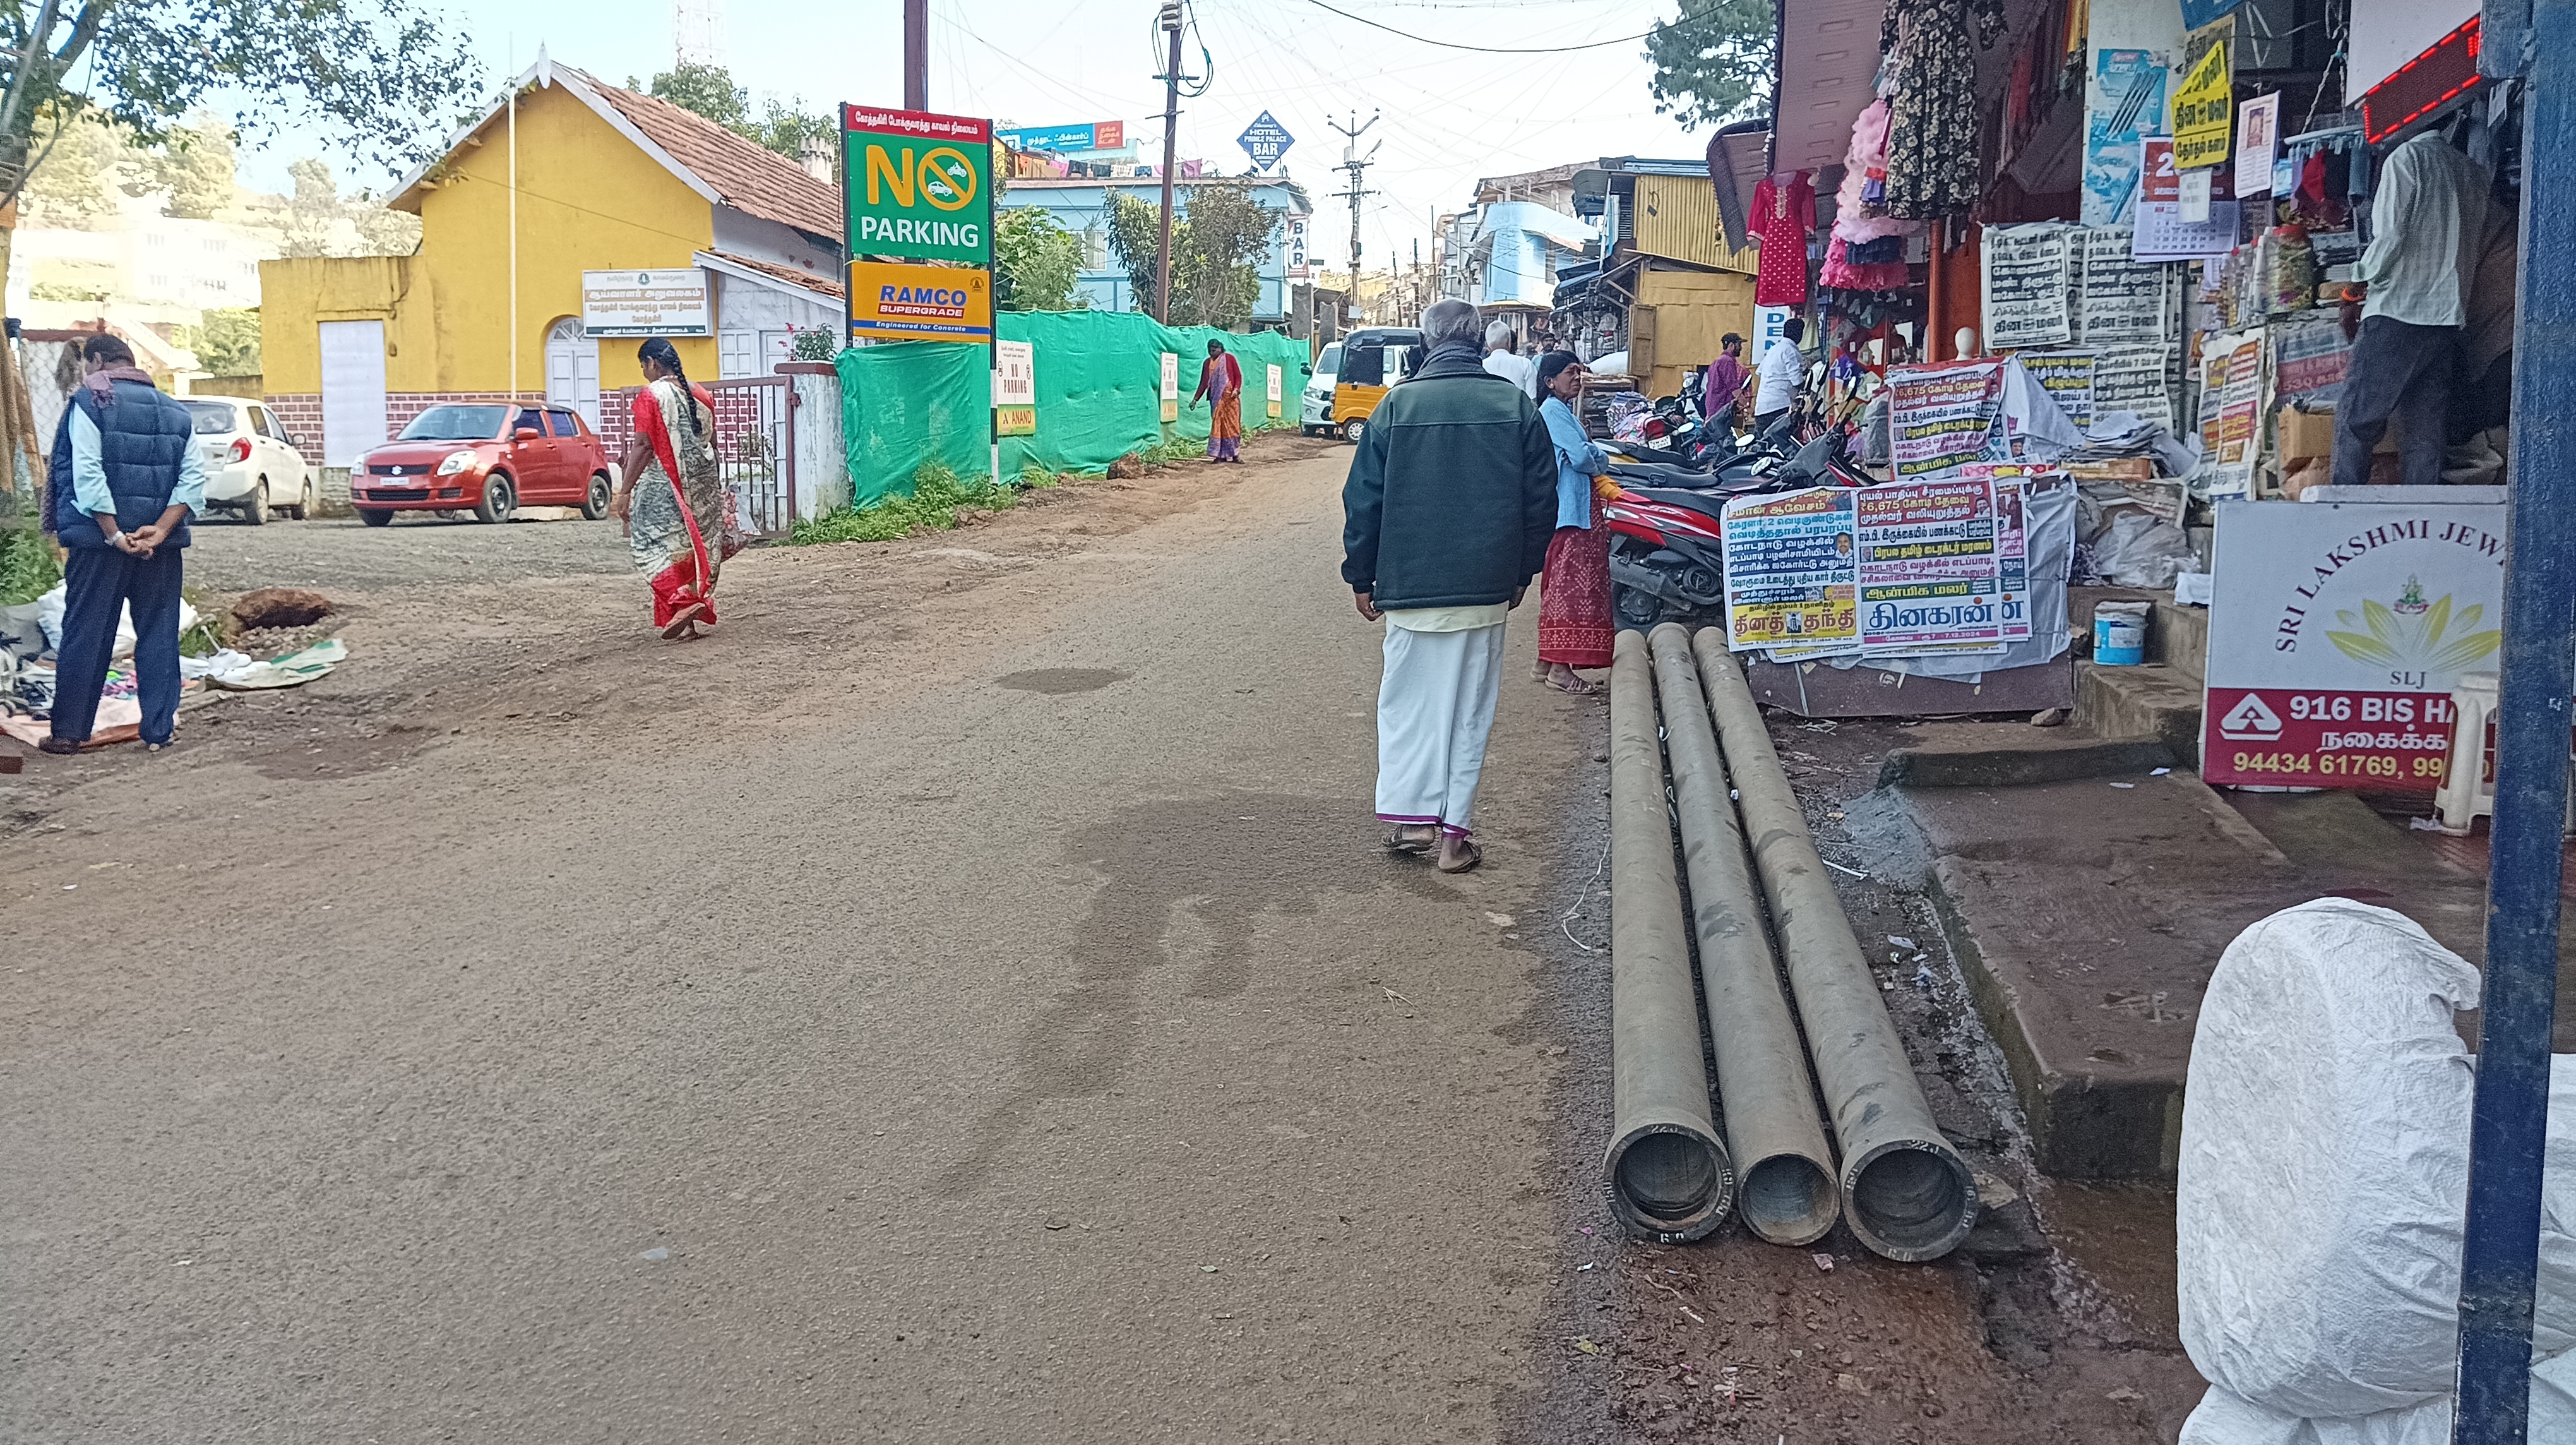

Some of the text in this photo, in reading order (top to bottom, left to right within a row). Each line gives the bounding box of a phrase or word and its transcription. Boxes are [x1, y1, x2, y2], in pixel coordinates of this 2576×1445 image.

[856, 111, 978, 135] கோத்தகிரி போக்குவரத்து காவல் நிலையம்
[1253, 143, 1278, 155] BAR
[861, 216, 978, 247] PARKING
[1292, 222, 1304, 265] BAR
[1993, 261, 2061, 275] கோவையில்
[1992, 272, 2063, 289] மண் திருட்டு
[589, 287, 701, 301] ஆய்வாளர் அலுவலகம்
[880, 285, 967, 306] RAMCO
[880, 305, 963, 316] SUPERGRADE
[1764, 313, 1785, 356] DEN
[1011, 364, 1018, 377] NO
[1004, 380, 1027, 393] PARKING
[1928, 384, 1953, 394] கோடி
[1955, 380, 1986, 390] தேவை
[1930, 388, 1986, 402] வலியுறுத்தல்
[1012, 411, 1032, 424] ANAND
[1911, 407, 1948, 424] இருக்கையில்
[1901, 456, 1952, 474] ஆன்மிக
[1860, 484, 1983, 501] புயல் பாதிப்பு சீரமைப்புக்கு
[1770, 500, 1825, 515] ஆவேசம்
[1861, 496, 1969, 512] ₹6,675 கோடி தேவை
[1777, 512, 1852, 525] வெடிகுண்டுகள்
[1860, 505, 1970, 525] முதல்வர் வலியுறுத்தல்
[1729, 522, 1852, 540] வெடித்ததால் பரபரப்பு
[1859, 523, 1965, 543] எம்.பி. இருக்கையில் பணக்கட்டு
[1729, 536, 1834, 552] கோடநாடு வழக்கில்
[1875, 539, 1992, 559] பிரபல தமிழ் டைரக்டர் மரணம்
[1729, 546, 1835, 563] எடப்பாடி பழனிசாமியிடம்
[1729, 556, 1854, 573] விசாரிக்க ஐகோர்ட்டு அனுமதி
[1910, 556, 1949, 572] வழக்கில்
[1797, 573, 1813, 585] புதிய
[1815, 572, 1828, 582] கார்
[1830, 570, 1855, 584] திருட்டு
[2275, 519, 2504, 653] SRI LAKSHMI JEW
[1781, 593, 1804, 601] மலர்
[1866, 585, 1929, 600] ஆன்மிக
[1934, 582, 1968, 595] மலர்
[1734, 608, 1855, 637] தினத் தந்தி
[1866, 597, 1995, 632] தினகரன்
[2390, 671, 2427, 690] SLJ
[2290, 697, 2454, 723] 916 BIS H
[2234, 752, 2311, 774] 94434
[2320, 755, 2404, 779] 61769,
